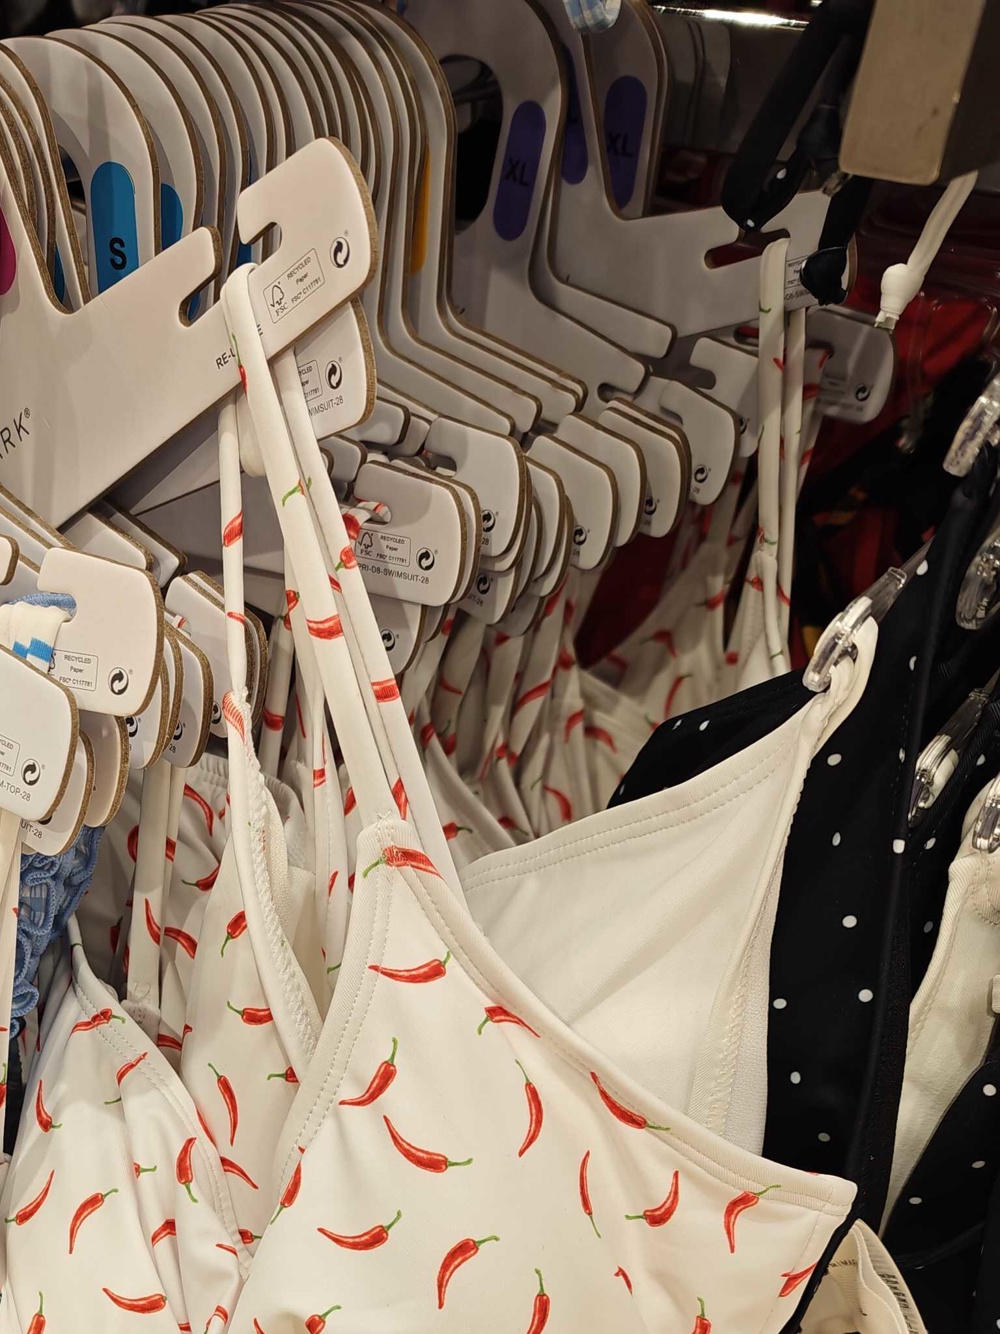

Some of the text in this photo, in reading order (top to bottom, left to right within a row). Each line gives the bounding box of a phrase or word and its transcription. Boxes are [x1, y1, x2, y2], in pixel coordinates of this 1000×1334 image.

[607, 132, 633, 157] XL
[504, 158, 529, 187] XL
[109, 237, 127, 271] S
[286, 256, 311, 280] RECYCLED
[296, 272, 309, 285] Paper
[275, 302, 288, 316] FSC
[380, 534, 405, 544] RECYCLED
[360, 549, 373, 557] FSC
[64, 654, 91, 664] RECYCLED
[70, 665, 84, 673] Paper
